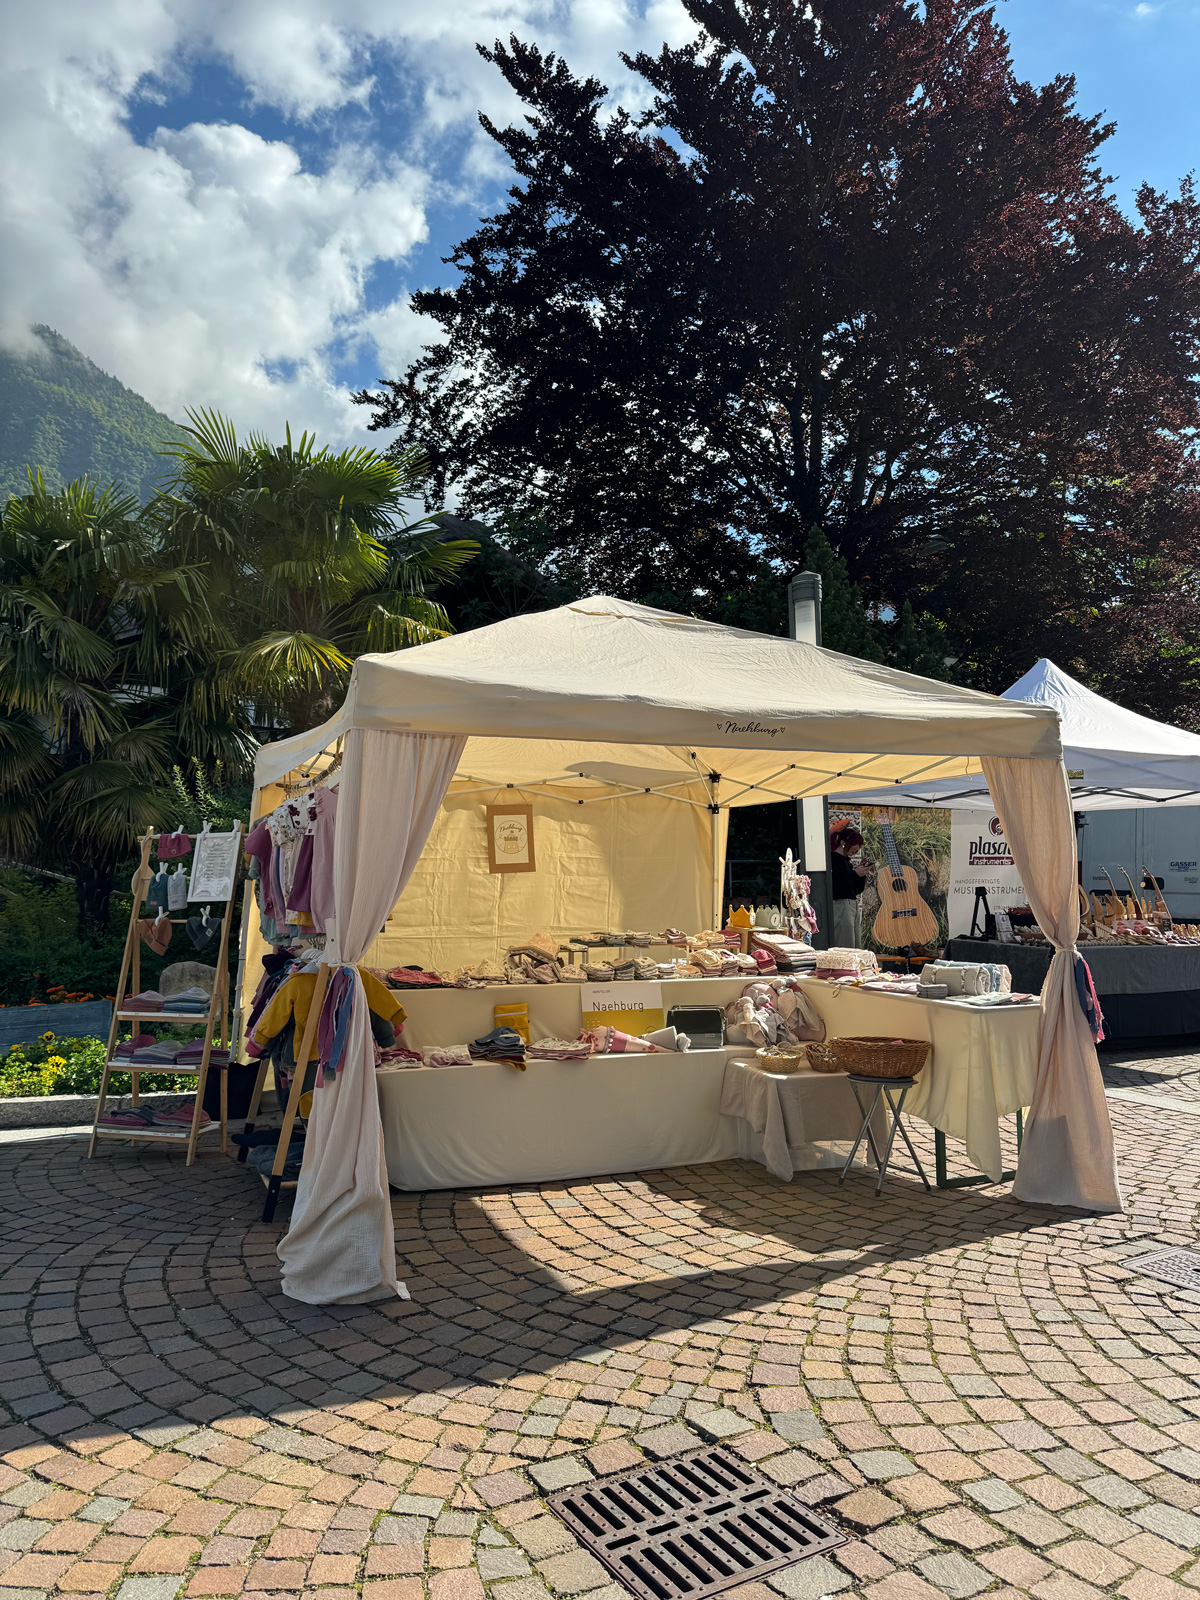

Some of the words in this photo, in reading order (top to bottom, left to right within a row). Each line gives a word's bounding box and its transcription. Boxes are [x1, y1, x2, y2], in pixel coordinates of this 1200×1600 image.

[725, 721, 779, 737] Naehburg
[499, 823, 523, 833] Naehburg
[953, 886, 1025, 895] MUSINSTRUME
[592, 1001, 644, 1012] Naehburg
